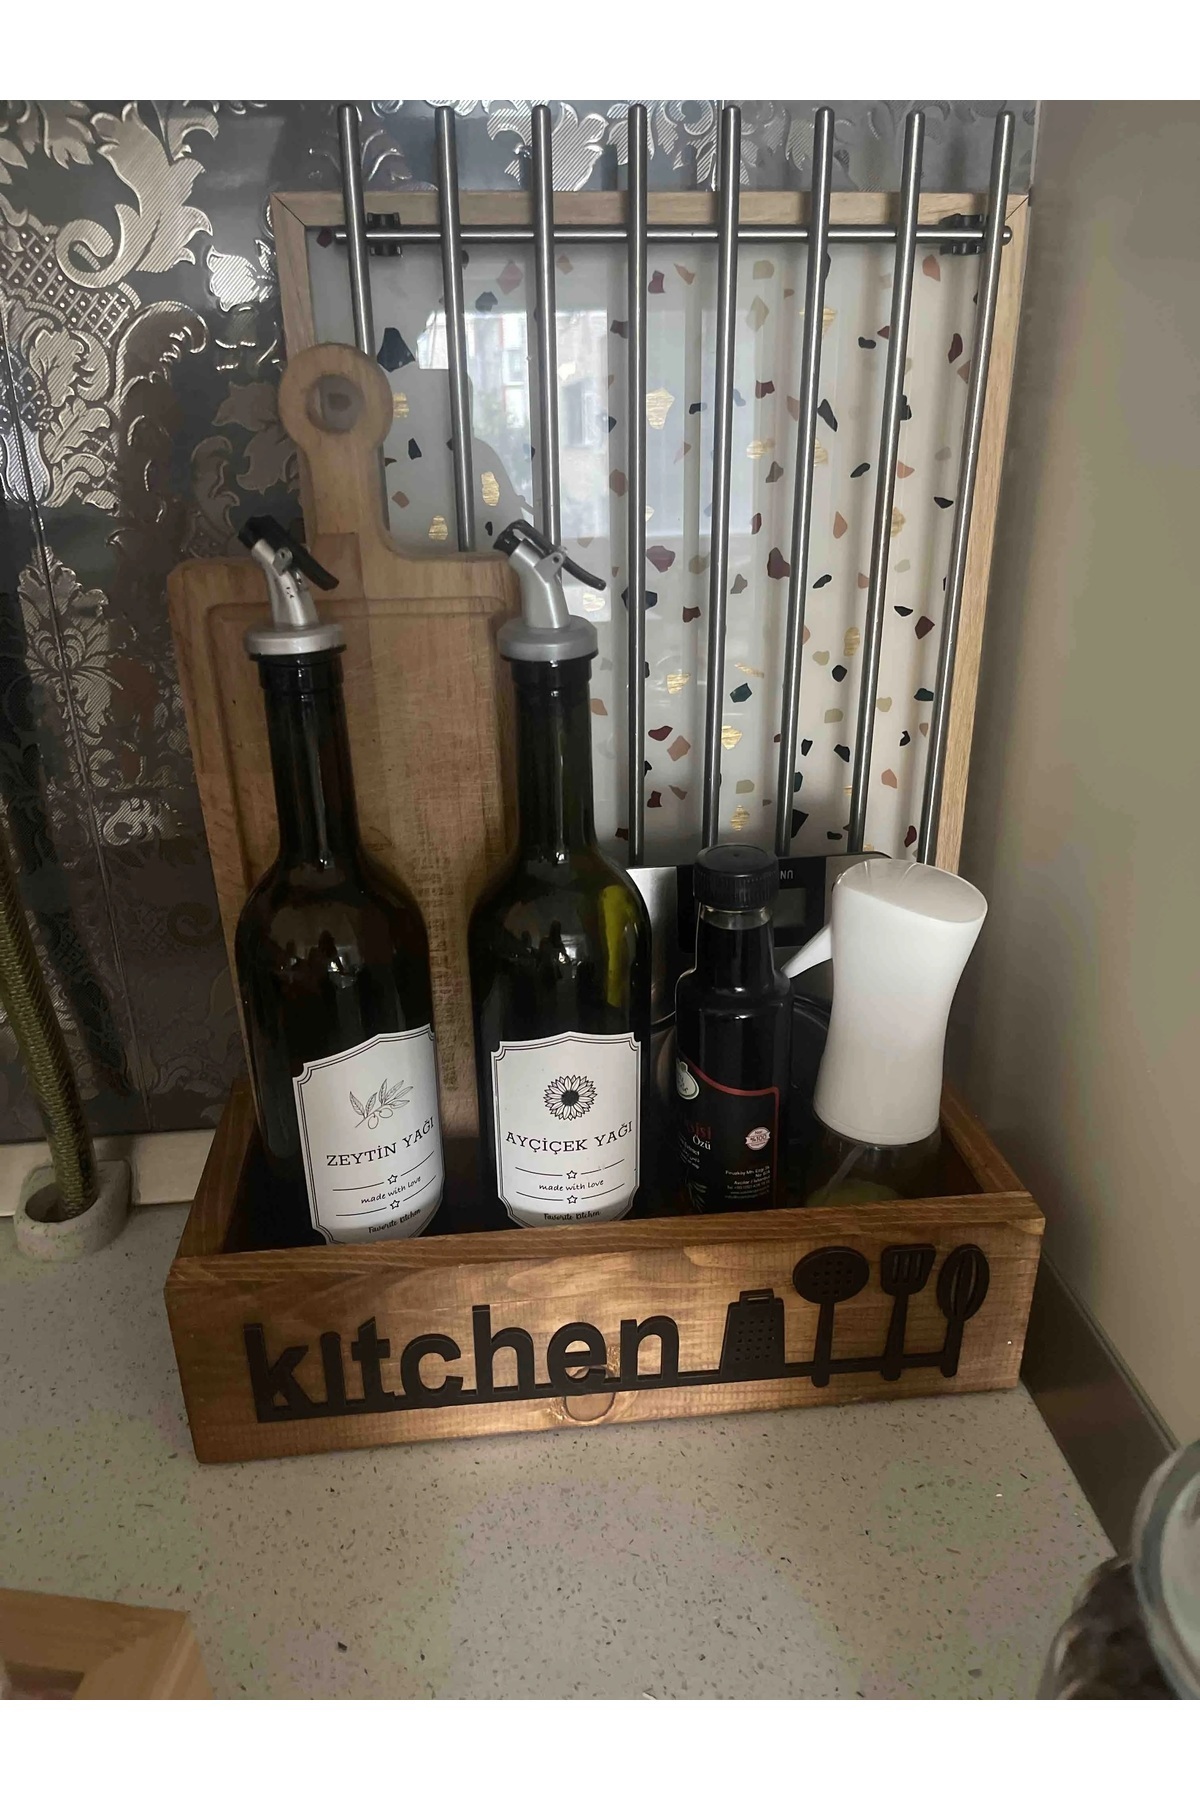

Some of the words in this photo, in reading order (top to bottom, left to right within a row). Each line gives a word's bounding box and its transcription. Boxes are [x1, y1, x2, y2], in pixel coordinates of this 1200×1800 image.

[326, 1142, 397, 1167] ZEYTİN
[401, 1116, 435, 1149] YAĞI
[505, 1131, 588, 1155] AYÇİÇEK
[594, 1120, 633, 1147] YAĞI
[361, 1193, 386, 1204] made
[387, 1185, 406, 1197] with
[407, 1176, 422, 1189] love
[539, 1184, 564, 1192] made
[565, 1183, 586, 1191] with
[587, 1179, 604, 1189] love
[368, 1219, 398, 1234] Favorite
[243, 1304, 681, 1423] kitchen
